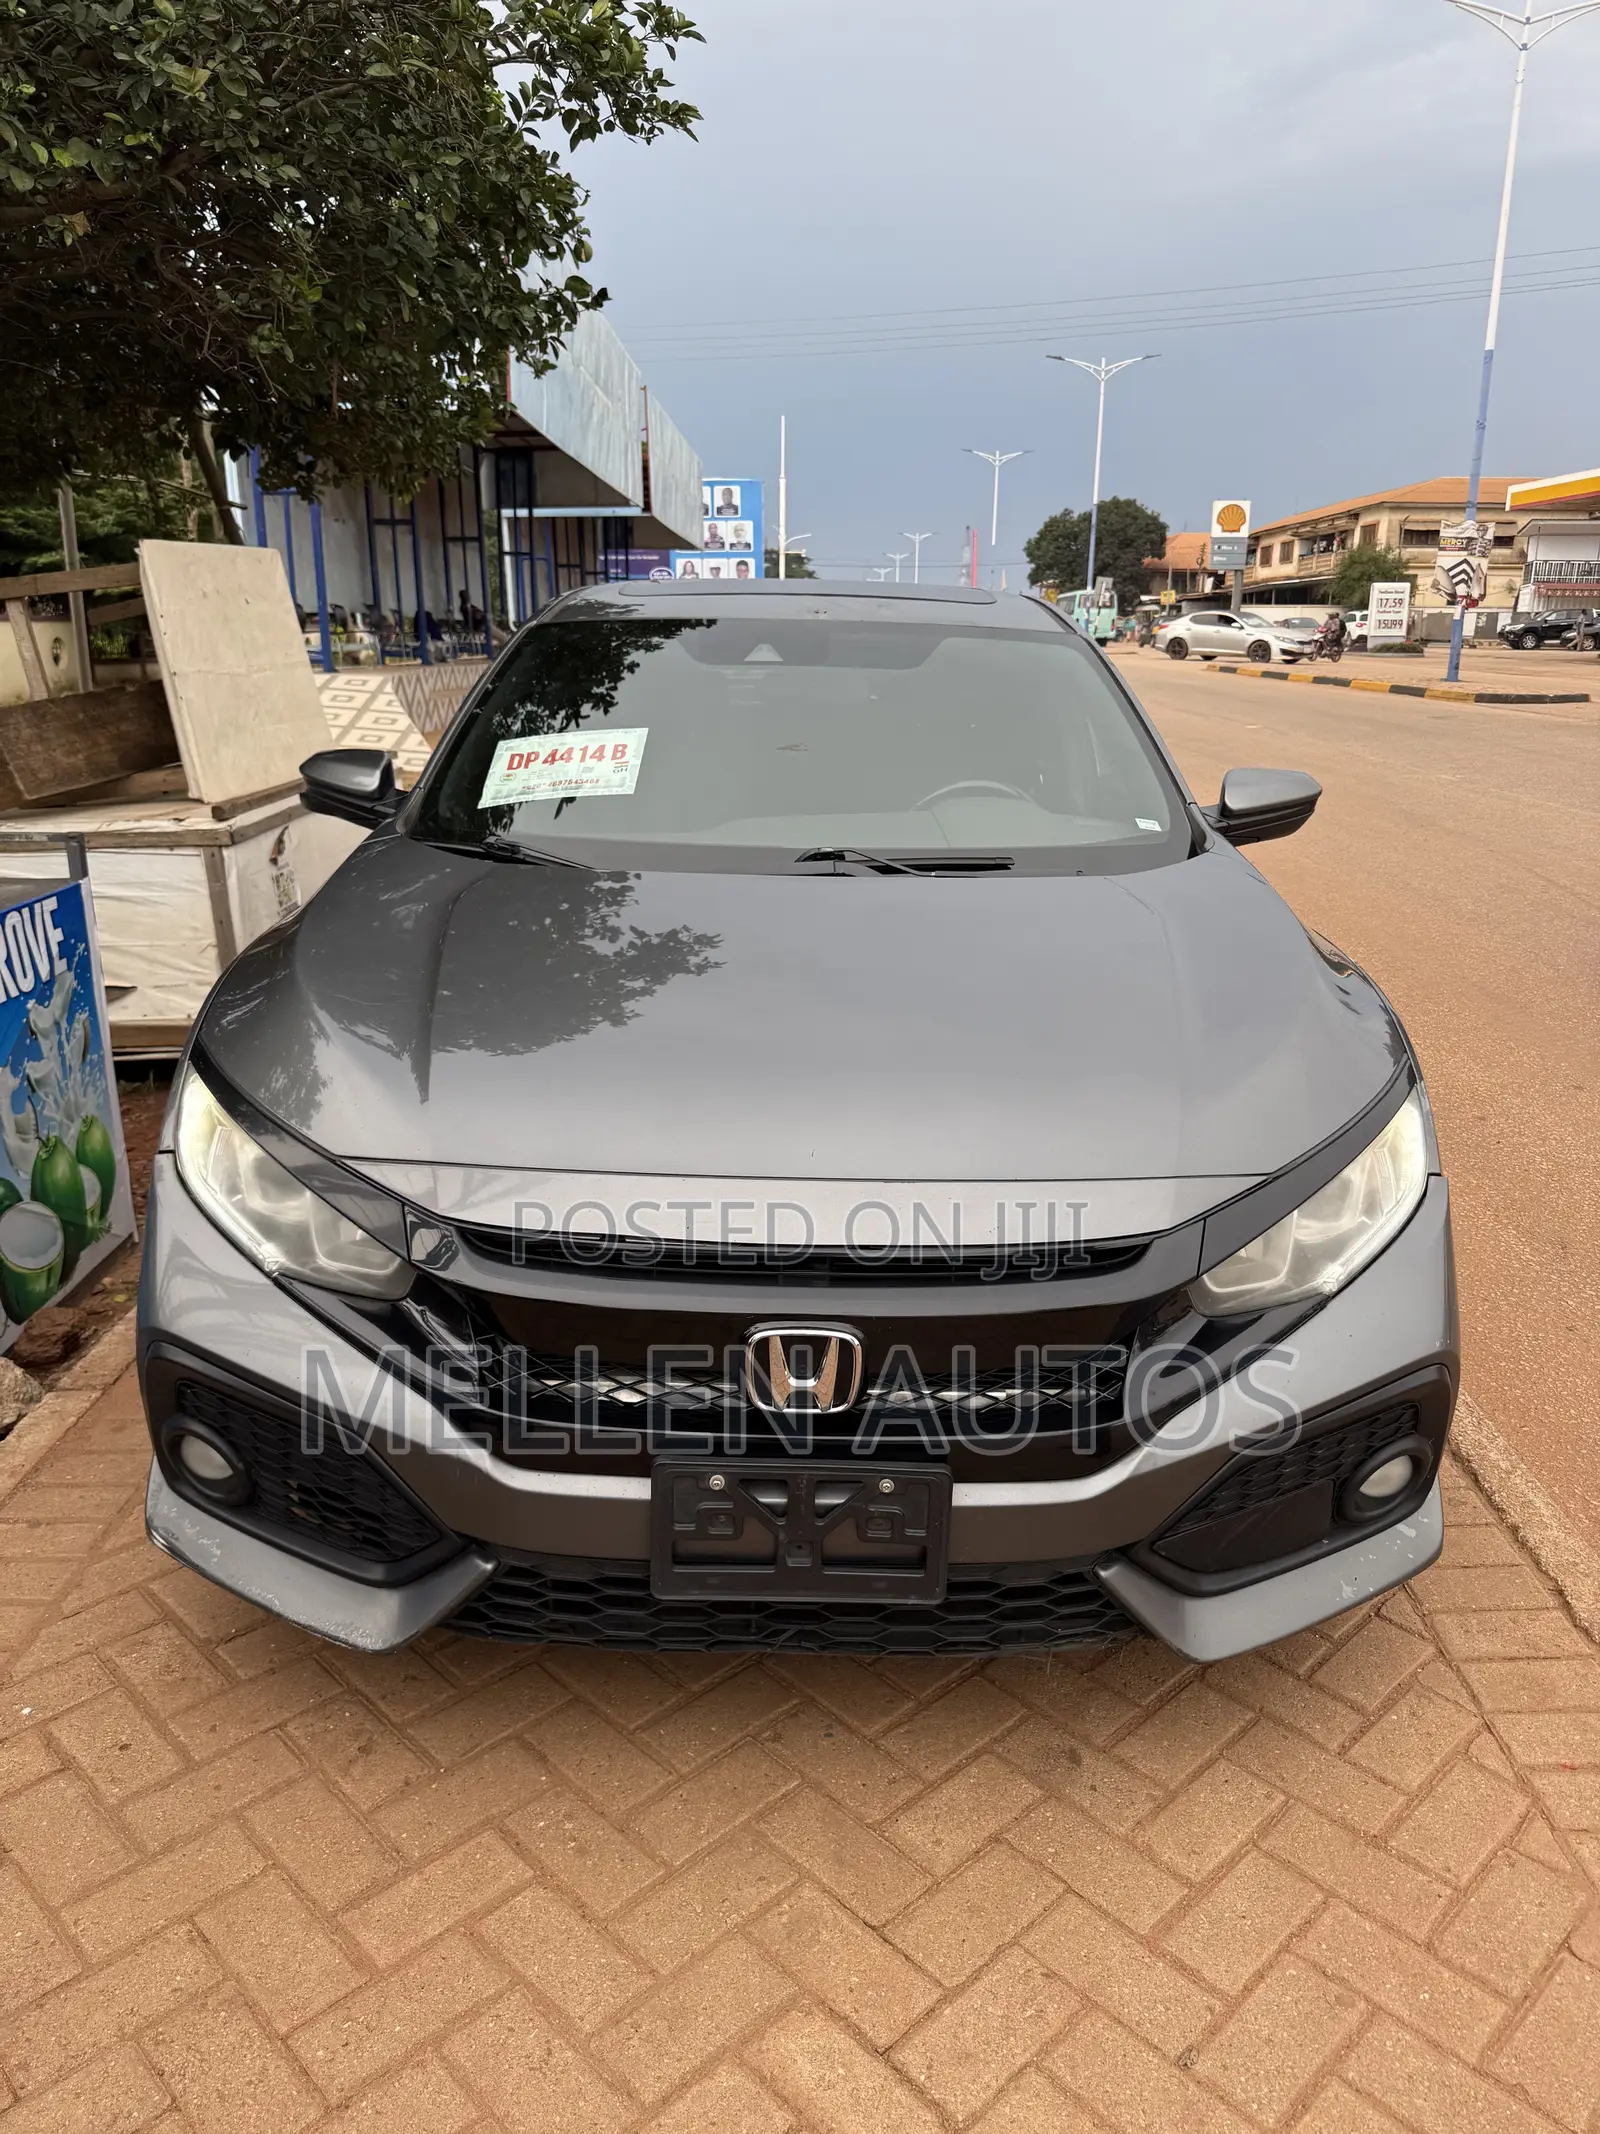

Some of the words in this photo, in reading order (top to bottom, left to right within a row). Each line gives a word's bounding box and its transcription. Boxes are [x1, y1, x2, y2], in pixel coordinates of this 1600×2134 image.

[1440, 538, 1467, 546] MERCY
[1380, 598, 1404, 608] 17.59
[506, 751, 540, 771] DP
[542, 744, 606, 766] 4414
[610, 743, 628, 761] B
